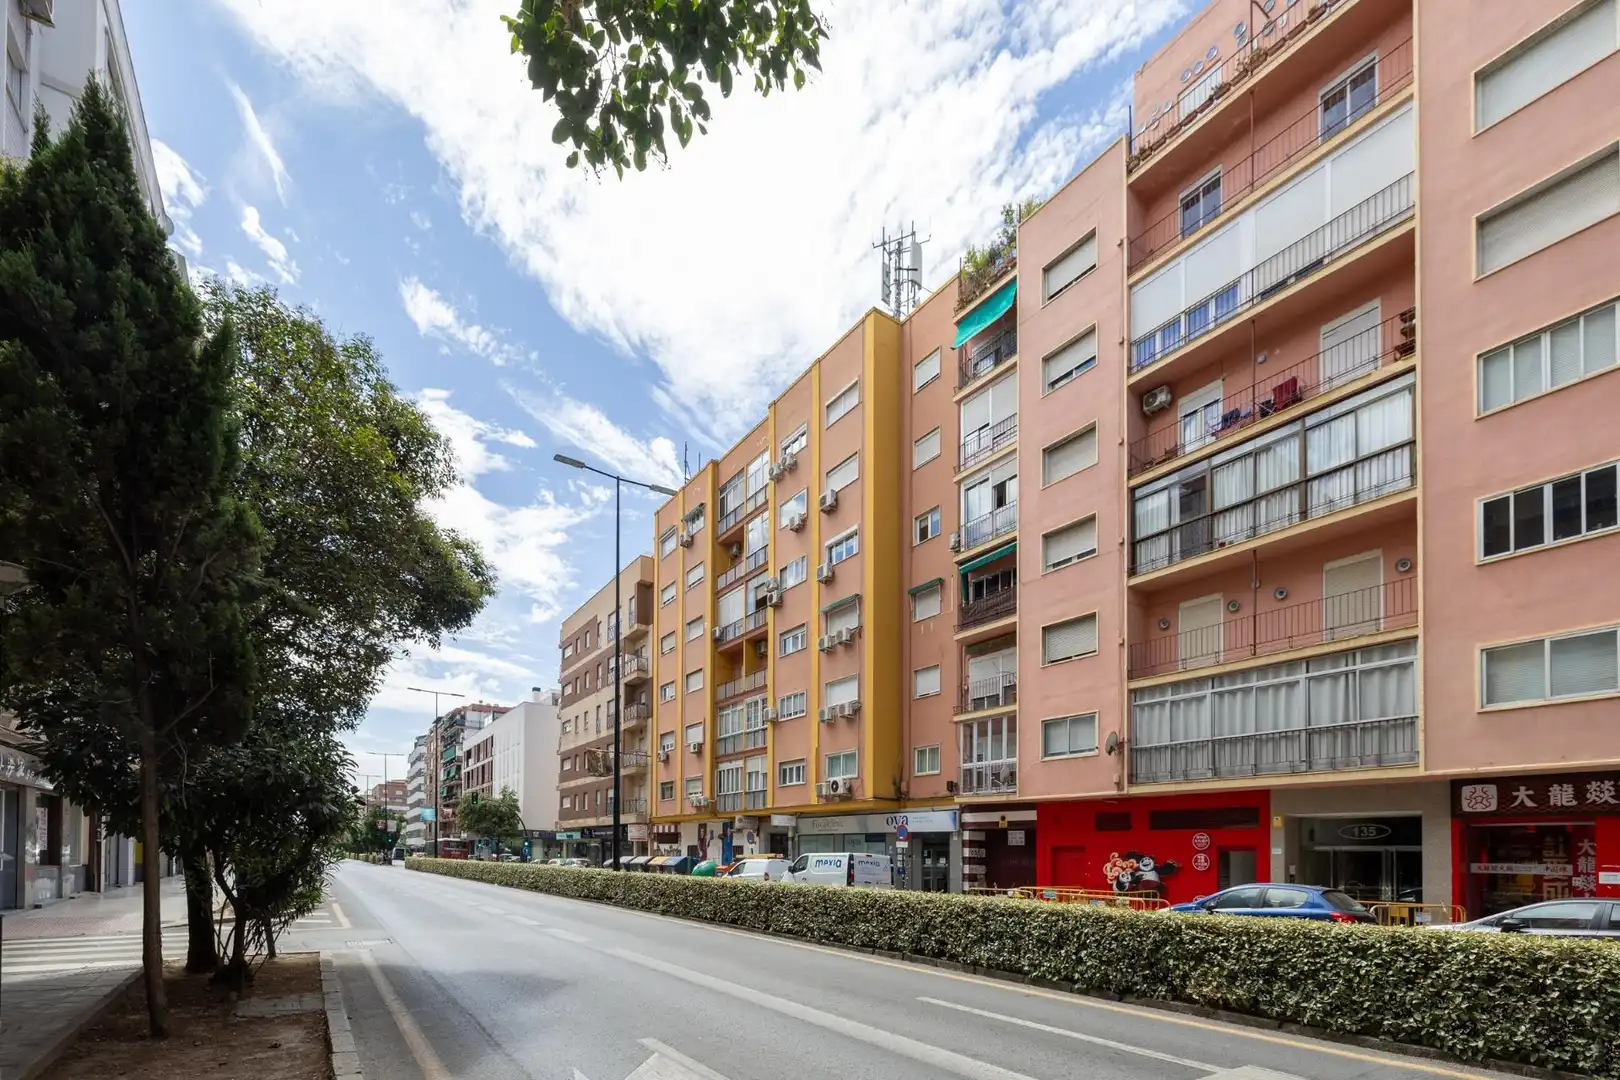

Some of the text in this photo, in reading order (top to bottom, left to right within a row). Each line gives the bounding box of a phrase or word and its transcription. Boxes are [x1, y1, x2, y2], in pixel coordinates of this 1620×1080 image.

[1510, 780, 1620, 808] 大龍燚
[1351, 826, 1377, 837] 135
[1577, 838, 1597, 899] 大龍燚
